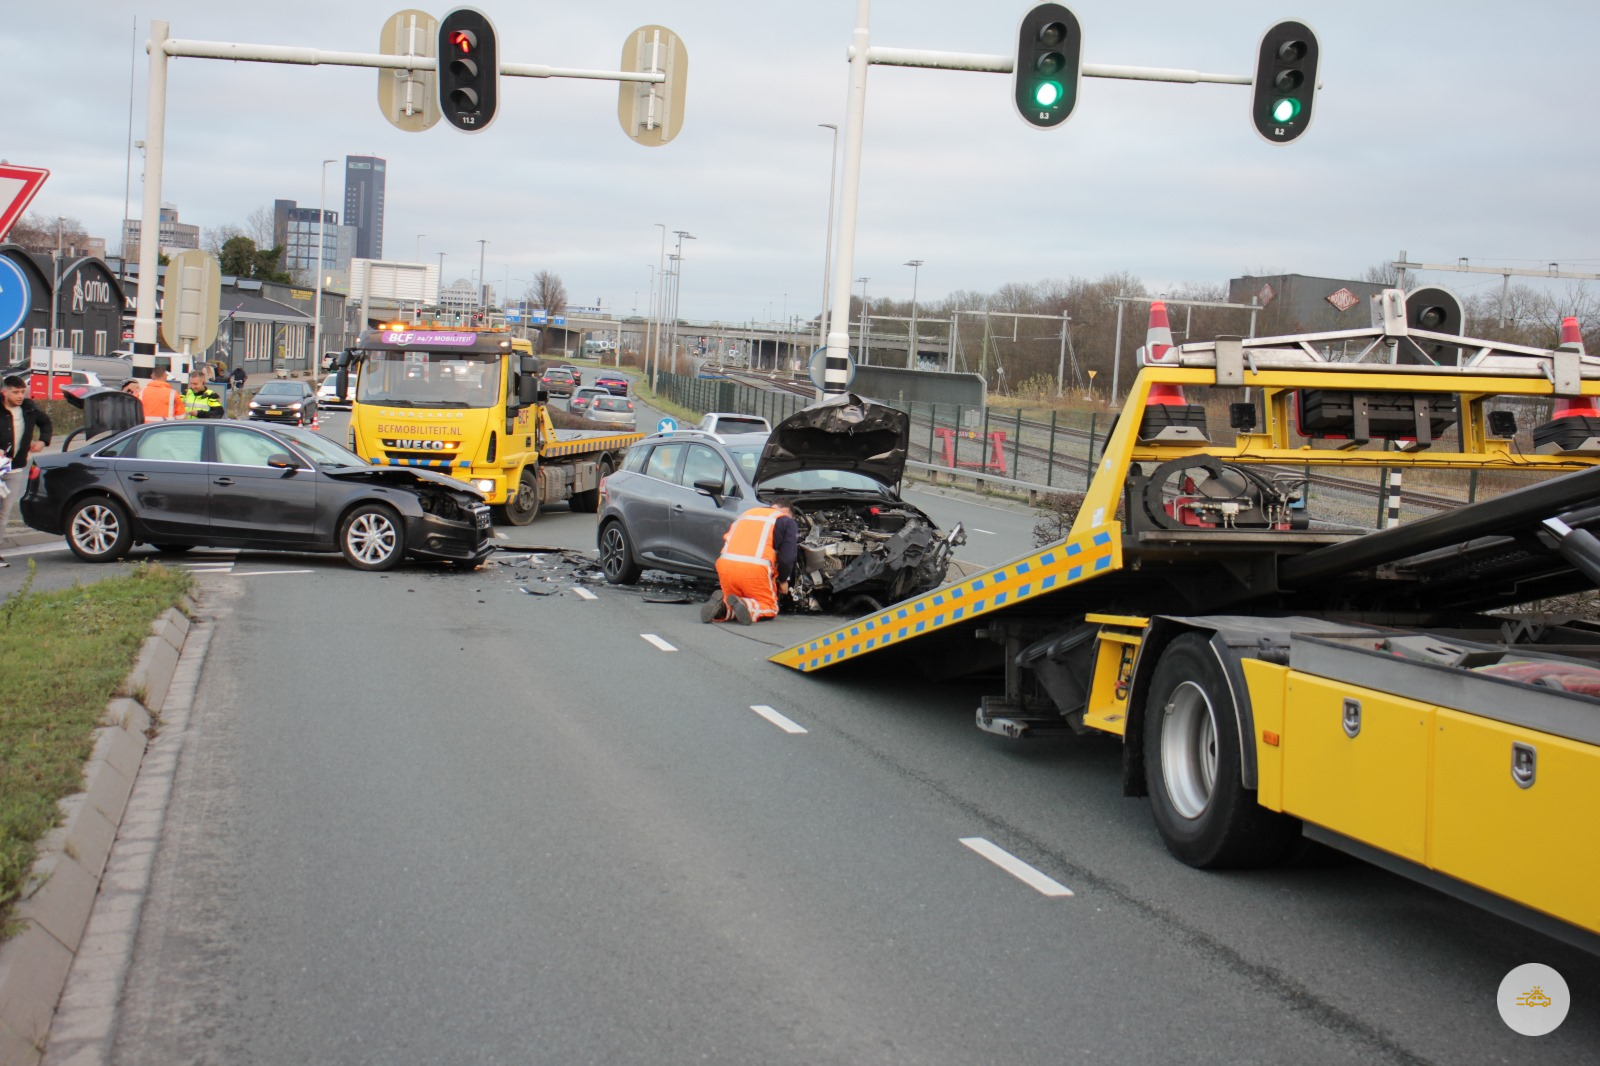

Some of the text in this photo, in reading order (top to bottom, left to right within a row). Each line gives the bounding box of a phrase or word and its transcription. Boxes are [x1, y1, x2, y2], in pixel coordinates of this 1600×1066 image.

[388, 333, 414, 343] BCF
[518, 409, 529, 424] BCF
[378, 425, 462, 435] BCFMOBILITEIT.NL
[396, 439, 444, 450] IVECO
